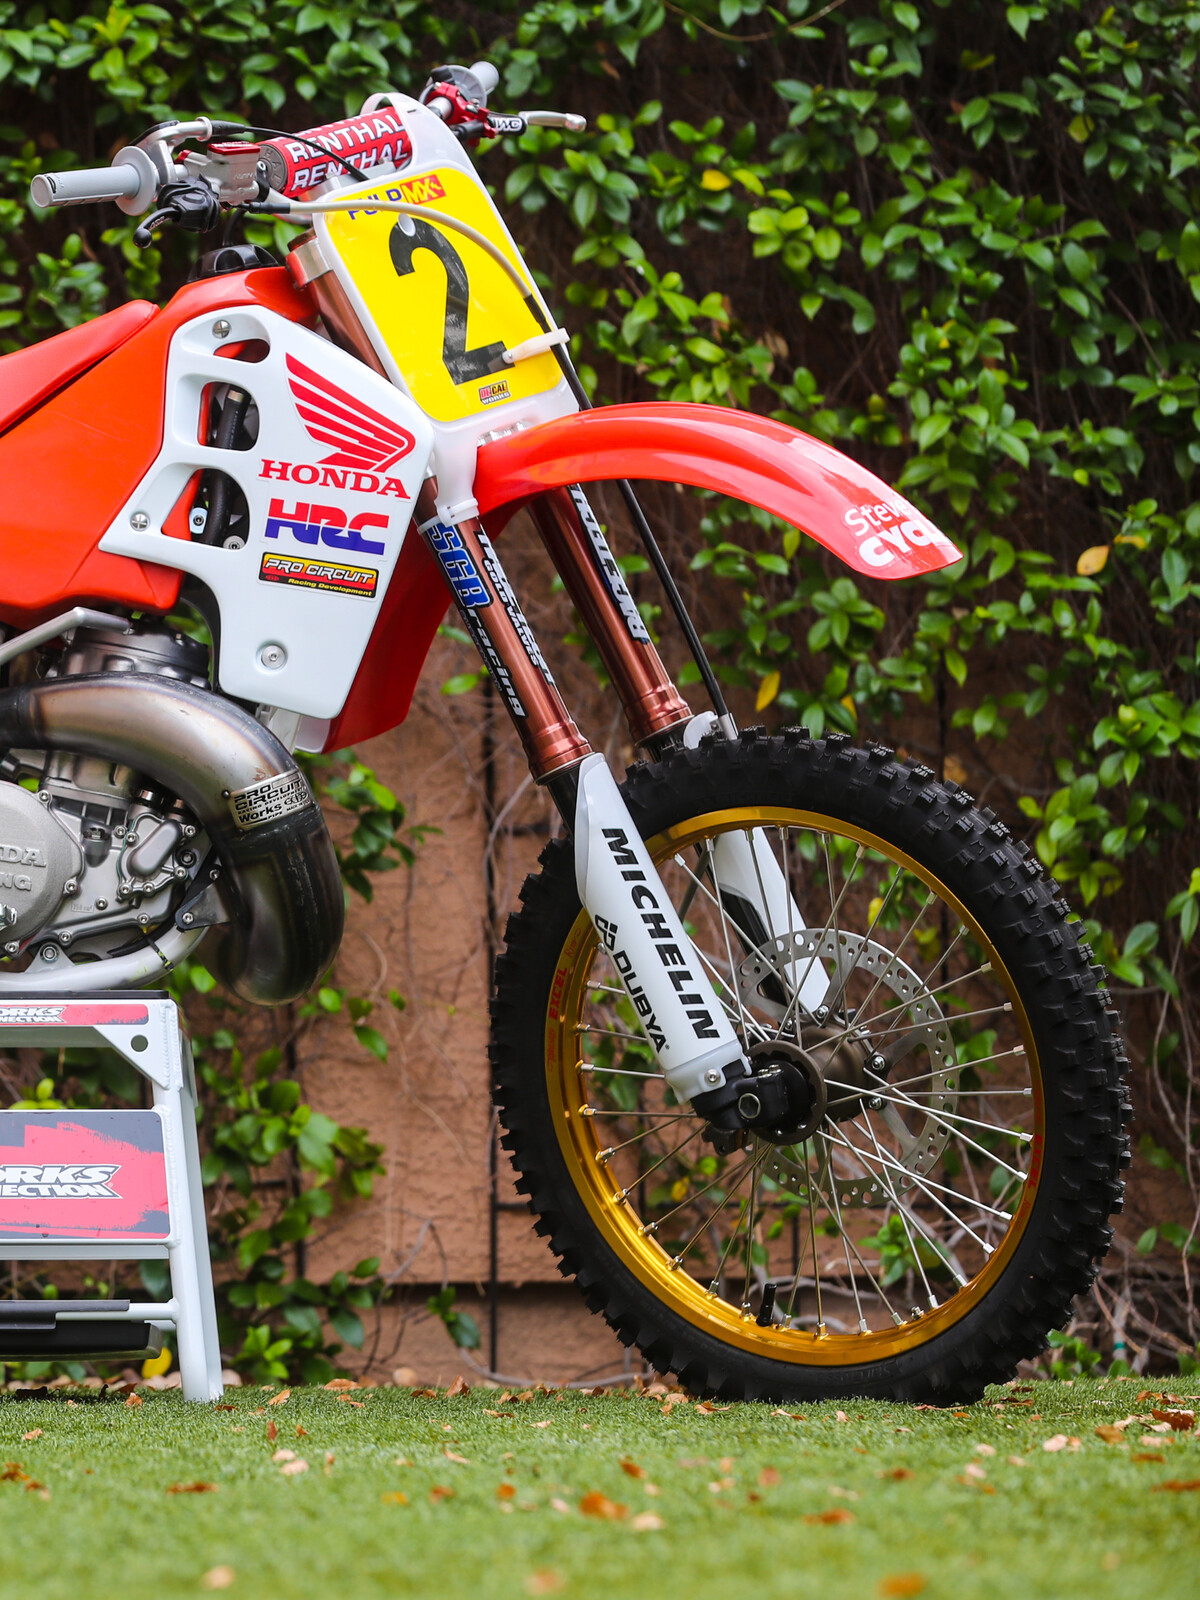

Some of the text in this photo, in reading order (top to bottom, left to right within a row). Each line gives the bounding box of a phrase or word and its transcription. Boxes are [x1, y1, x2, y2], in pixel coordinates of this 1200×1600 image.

[284, 114, 406, 163] RENTHAL
[389, 217, 515, 385] 2
[258, 459, 411, 500] HONDA
[264, 498, 390, 556] HRC
[264, 558, 373, 584] PRO CIRCUIT
[287, 578, 373, 597] Racing Development
[427, 523, 491, 608] SGB
[467, 608, 526, 718] racing
[483, 559, 540, 666] GOLD VALVES
[233, 784, 271, 804] PRO
[235, 779, 302, 811] CIRCUIT
[238, 803, 283, 824] Works
[601, 828, 721, 1040] MICHELIN
[548, 967, 568, 1021] EXCEL
[612, 950, 668, 1054] DUBYA
